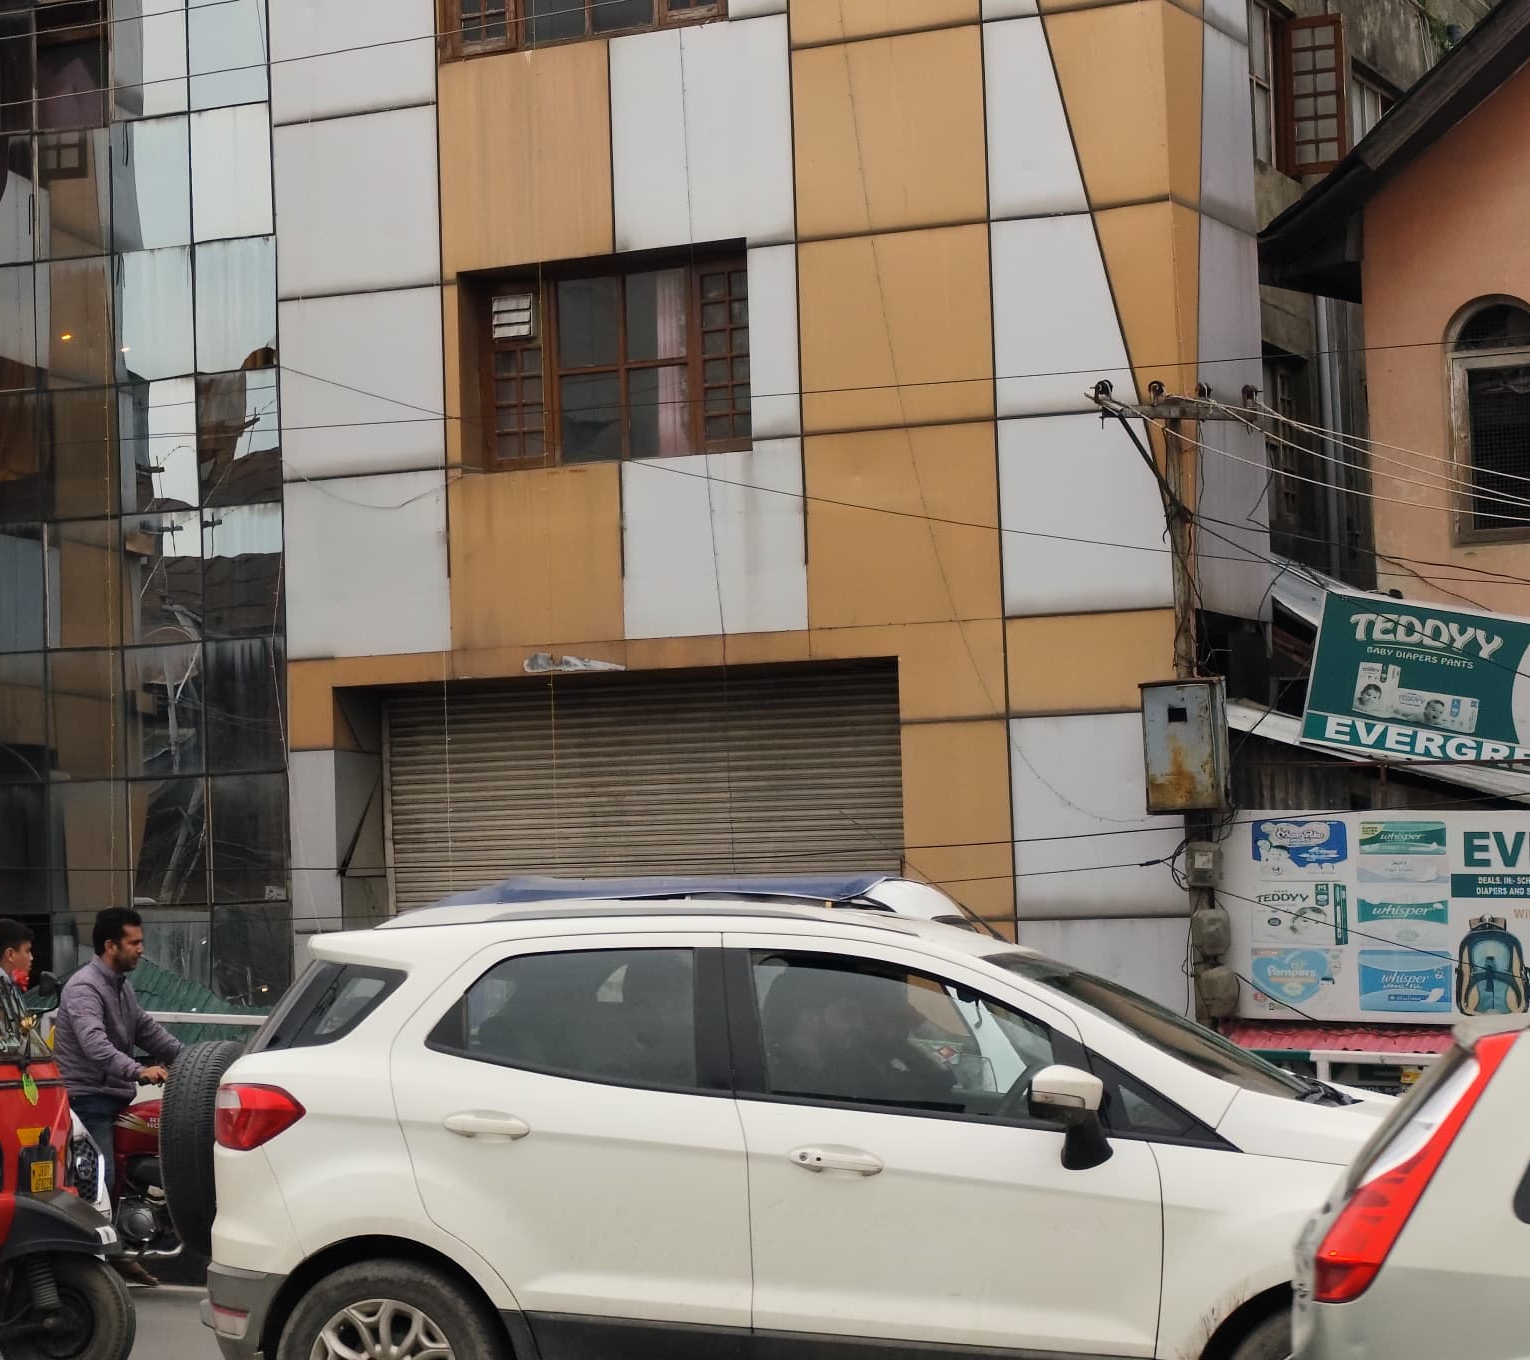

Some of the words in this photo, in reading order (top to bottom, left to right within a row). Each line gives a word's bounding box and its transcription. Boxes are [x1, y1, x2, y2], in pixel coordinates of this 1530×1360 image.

[1350, 612, 1504, 661] TEDDYY
[1366, 645, 1394, 660] BABY
[1395, 649, 1438, 665] DIAPERS
[1440, 656, 1475, 670] PANTS
[1380, 831, 1422, 842] whisper
[1463, 831, 1530, 868] EV
[1256, 893, 1310, 903] TEDDYY
[1476, 887, 1508, 895] DIAPERS
[1509, 887, 1525, 895] AND
[1371, 902, 1432, 916] whisper
[1267, 965, 1317, 979] Pampers
[1381, 971, 1430, 986] whisper
